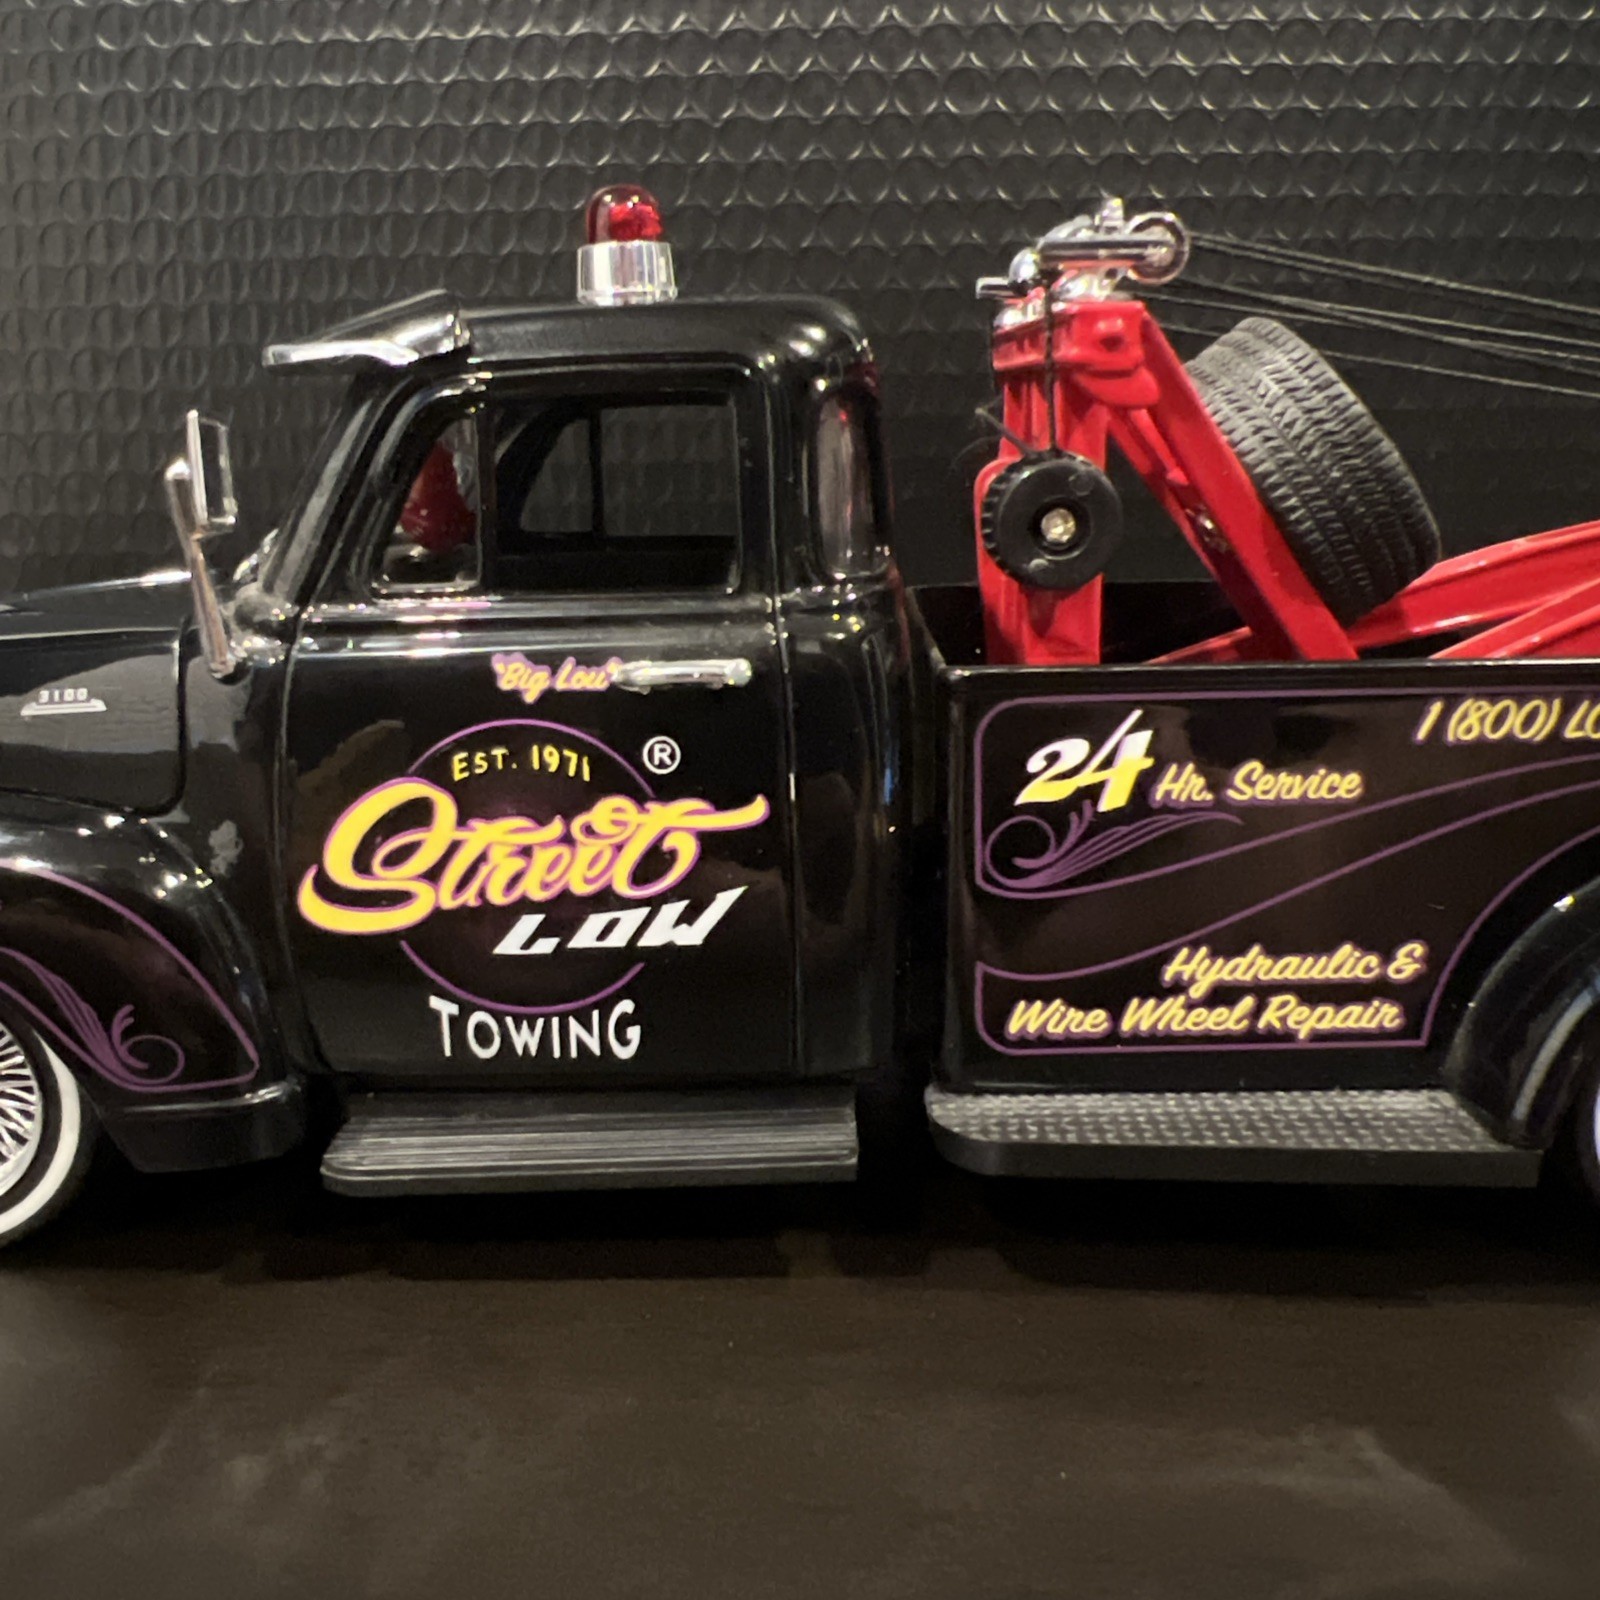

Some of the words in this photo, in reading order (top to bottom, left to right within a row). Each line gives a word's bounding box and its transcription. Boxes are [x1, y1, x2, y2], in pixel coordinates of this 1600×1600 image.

[1415, 700, 1443, 743] 1
[1445, 697, 1562, 745] (800)
[452, 746, 518, 782] EST.
[532, 743, 591, 782] 1971
[1013, 709, 1154, 813] 24
[1151, 762, 1215, 806] Hr.
[1225, 759, 1364, 804] Service
[298, 776, 770, 935] Street
[492, 885, 750, 956] LOW
[1161, 943, 1382, 999] Hydraulic
[1386, 942, 1427, 983] &
[428, 995, 642, 1060] TOWING
[1006, 997, 1110, 1040] Wire
[1118, 994, 1253, 1034] Wheel
[1255, 994, 1405, 1039] Repair
